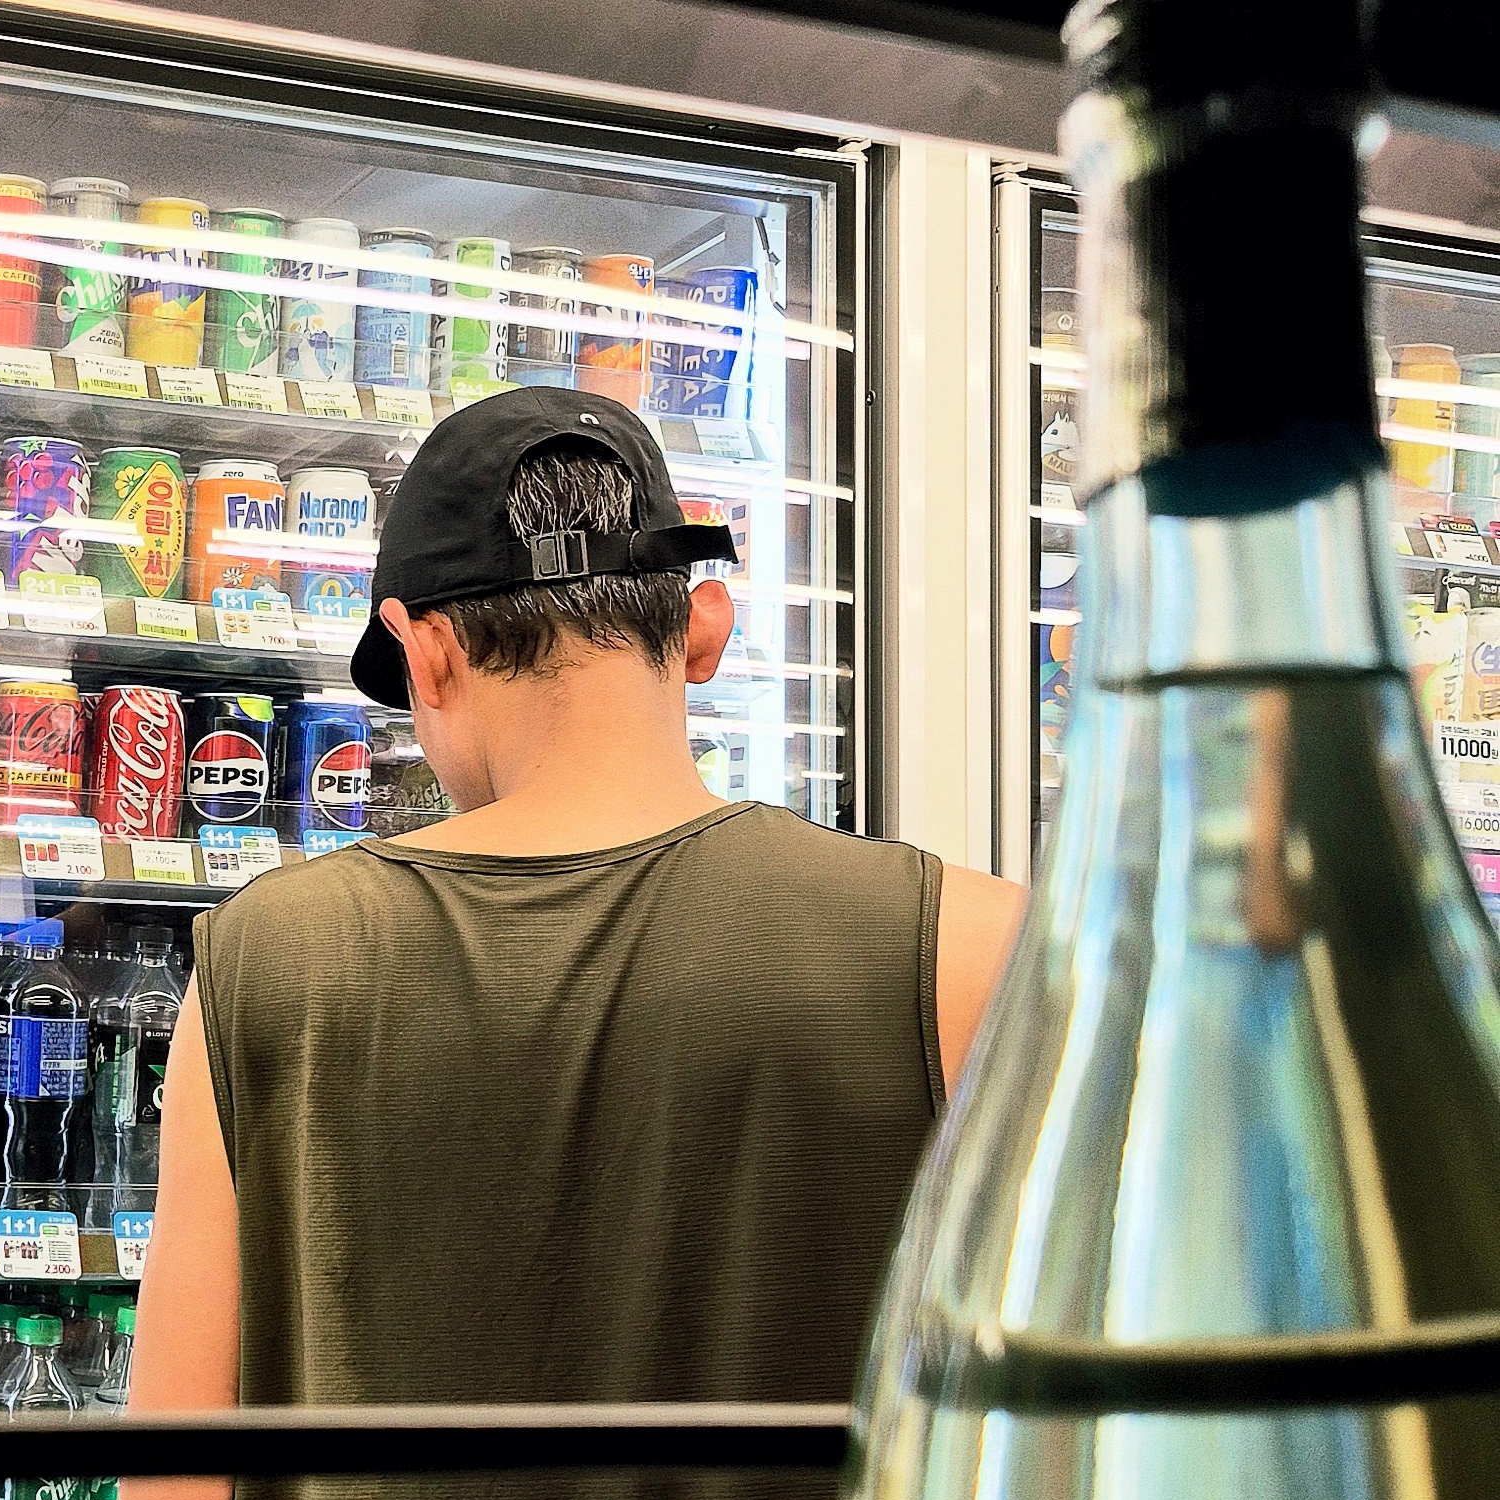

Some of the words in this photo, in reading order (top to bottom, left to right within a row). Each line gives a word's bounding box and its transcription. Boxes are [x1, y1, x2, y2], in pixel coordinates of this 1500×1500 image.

[223, 470, 244, 478] zero
[25, 578, 56, 595] 2+1
[219, 594, 247, 609] 1+1
[315, 601, 343, 616] 1+1
[8, 772, 69, 784] CAFFEINE
[190, 766, 264, 789] PEPSI
[206, 830, 236, 846] 1+1
[308, 836, 338, 850] 1+1
[1, 1217, 35, 1235] 1+1
